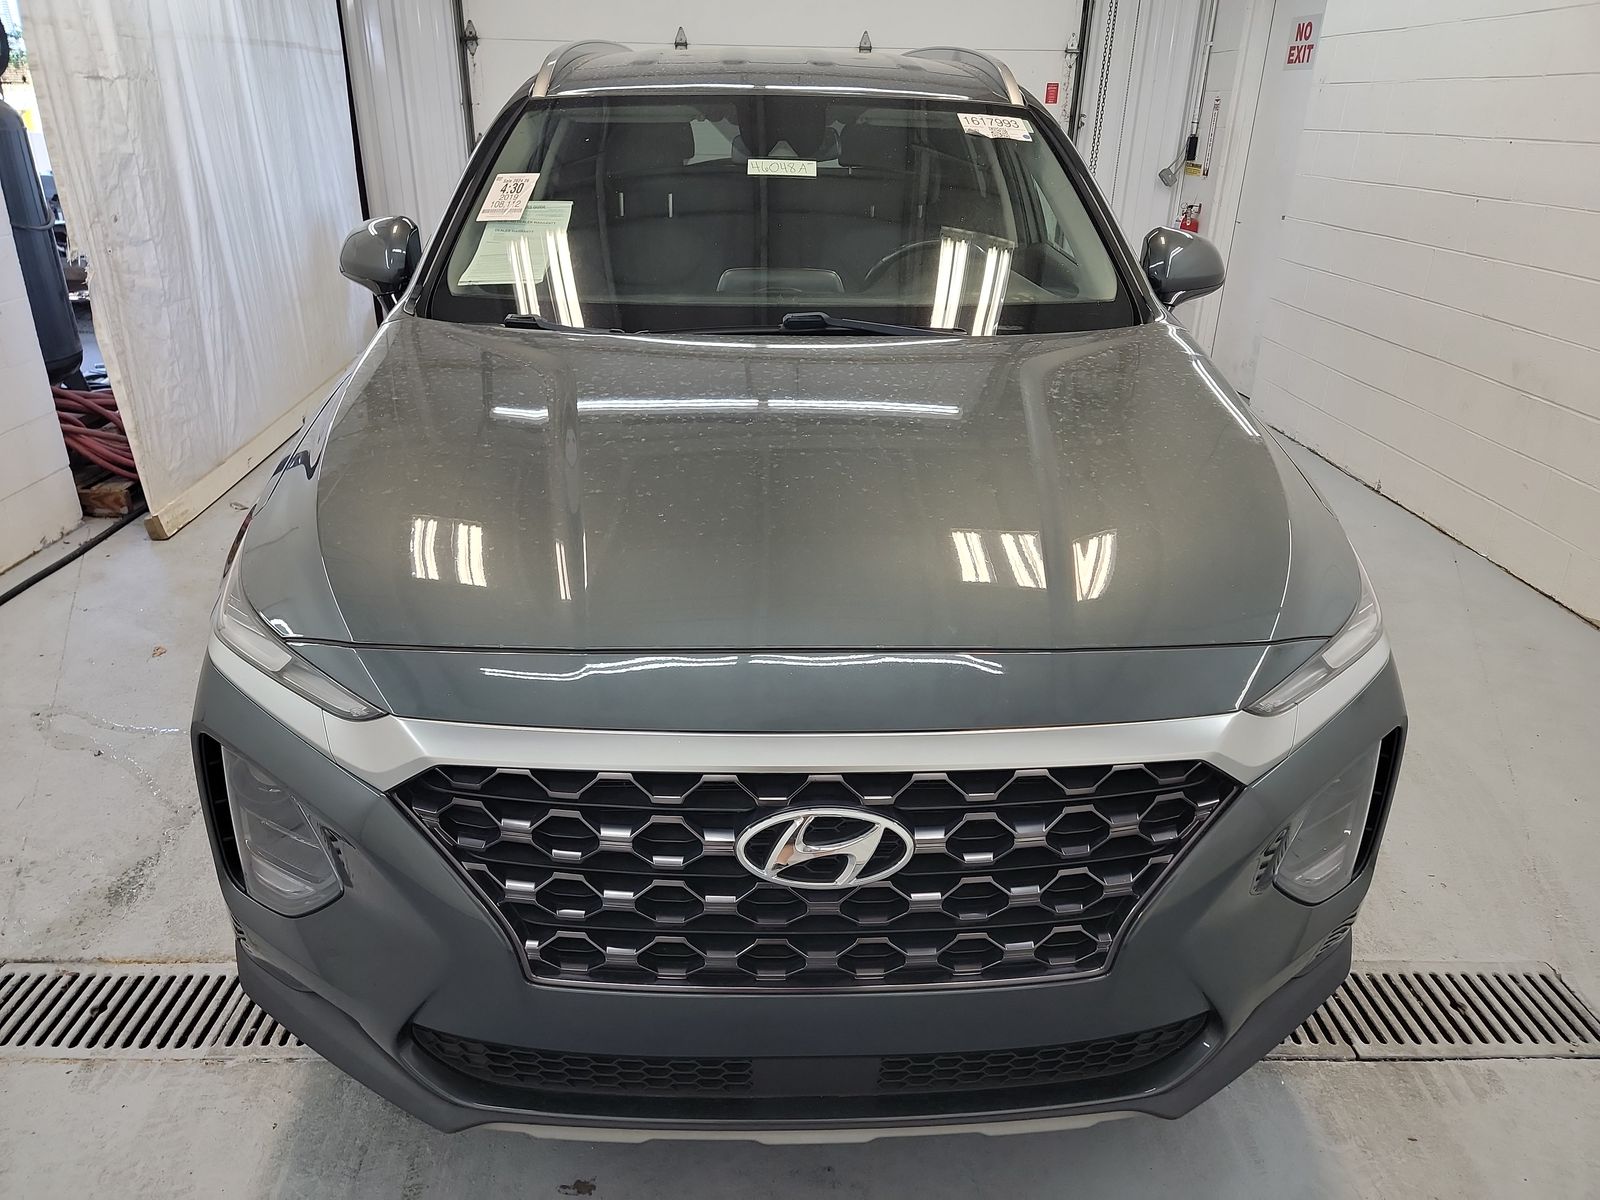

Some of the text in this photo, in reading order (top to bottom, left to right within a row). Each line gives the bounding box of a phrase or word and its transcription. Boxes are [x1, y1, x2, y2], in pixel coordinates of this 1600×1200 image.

[1295, 21, 1313, 41] NO
[1287, 44, 1314, 64] EXIT
[963, 116, 1020, 129] 1617993
[500, 182, 525, 194] 4:30
[499, 193, 520, 201] 2019
